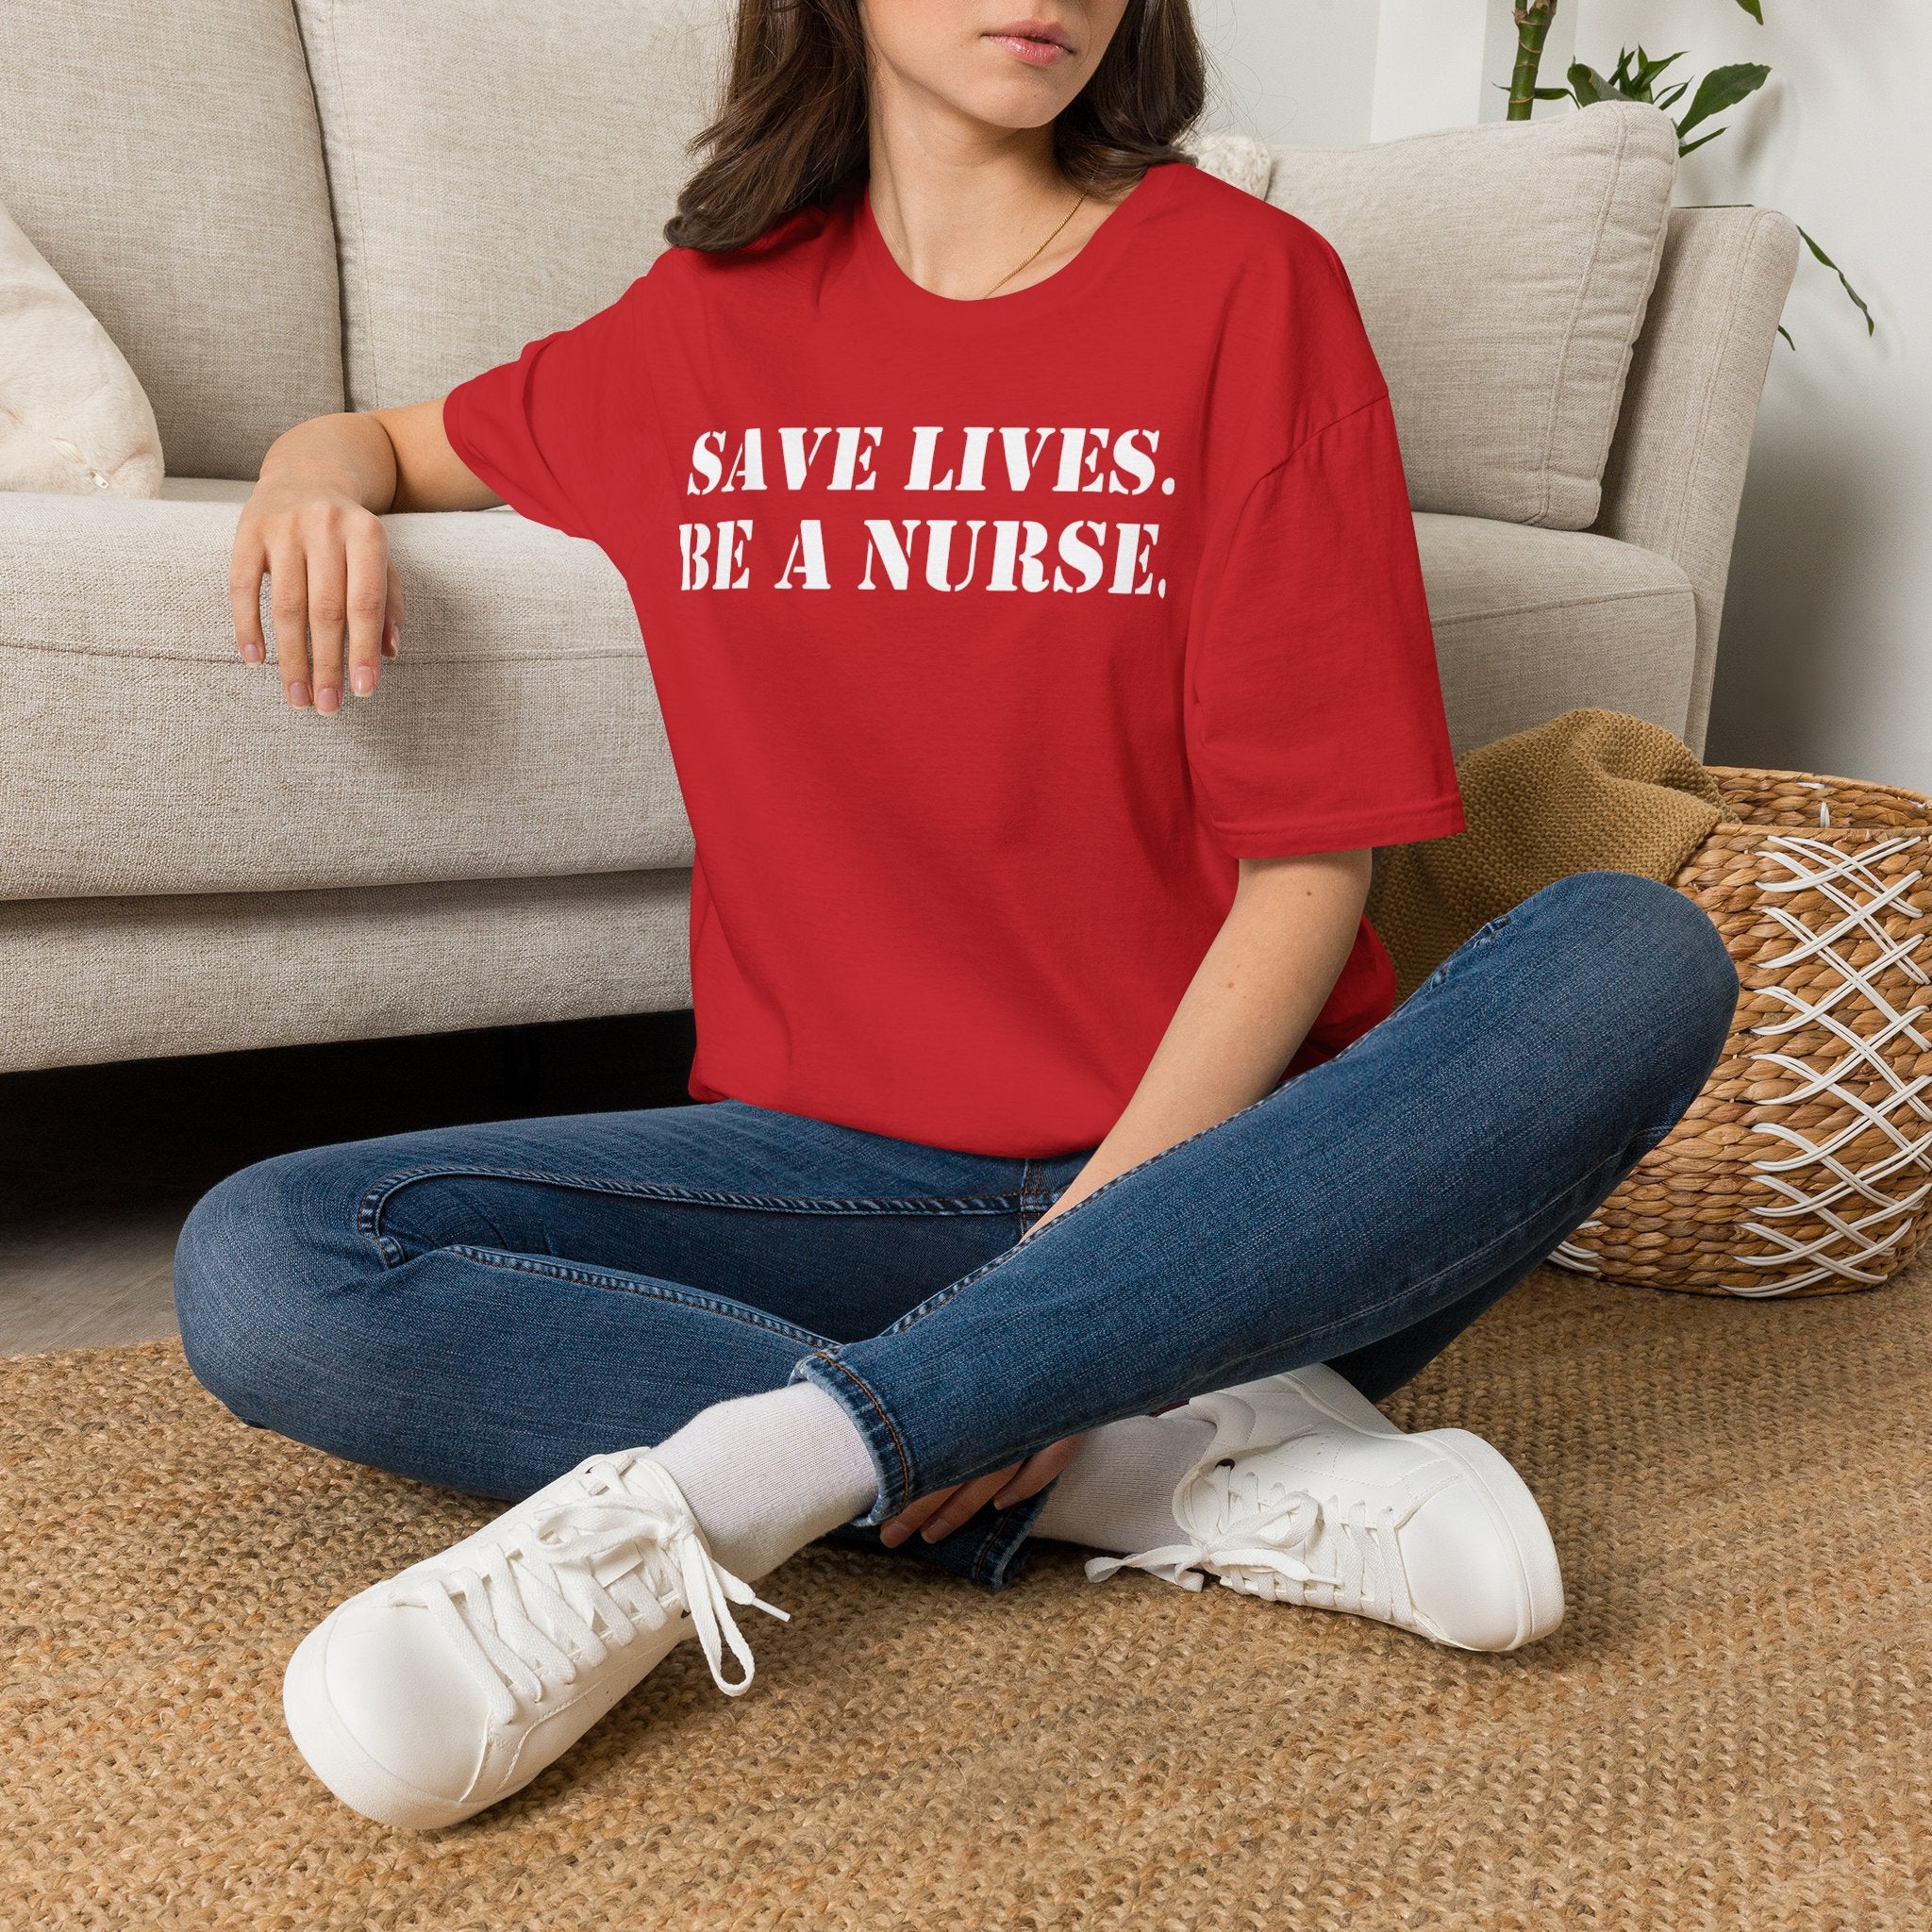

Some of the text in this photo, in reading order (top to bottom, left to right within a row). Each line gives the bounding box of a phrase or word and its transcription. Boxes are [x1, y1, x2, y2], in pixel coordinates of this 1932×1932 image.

[687, 425, 1175, 496] SAVE LIVES.
[678, 519, 1166, 599] BE A NURSE.
